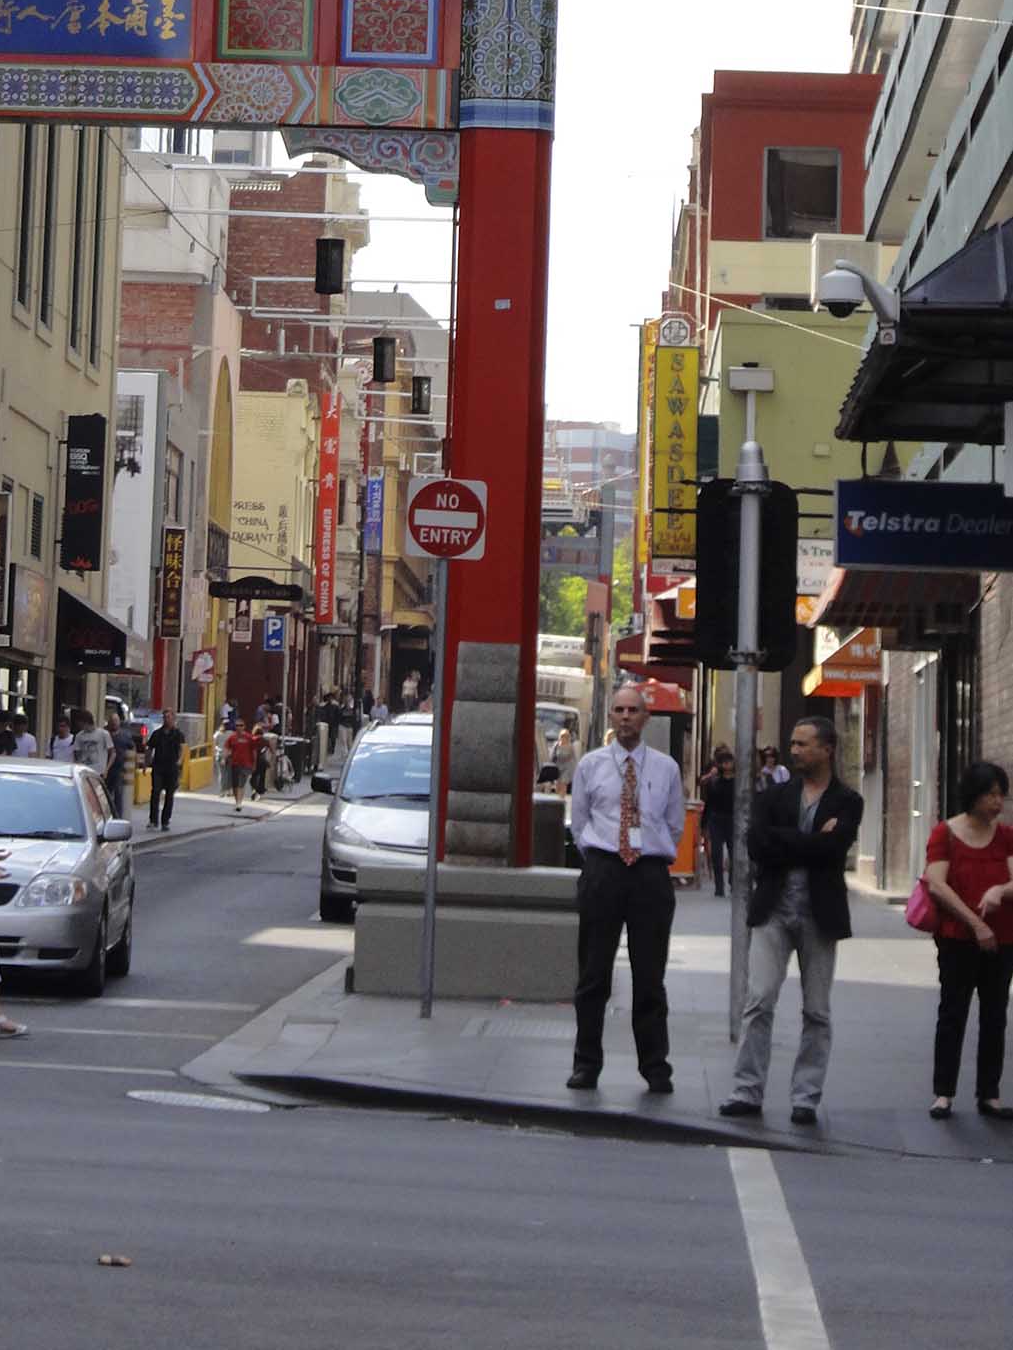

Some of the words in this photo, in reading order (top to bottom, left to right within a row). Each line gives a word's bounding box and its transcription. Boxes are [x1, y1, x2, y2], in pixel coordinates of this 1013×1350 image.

[667, 353, 690, 531] SAWASDEE
[436, 493, 460, 509] NO
[846, 510, 939, 533] Telstra
[322, 508, 333, 560] EMPRESS
[419, 528, 472, 546] ENTRY
[319, 580, 330, 615] CHINA
[267, 618, 283, 635] P
